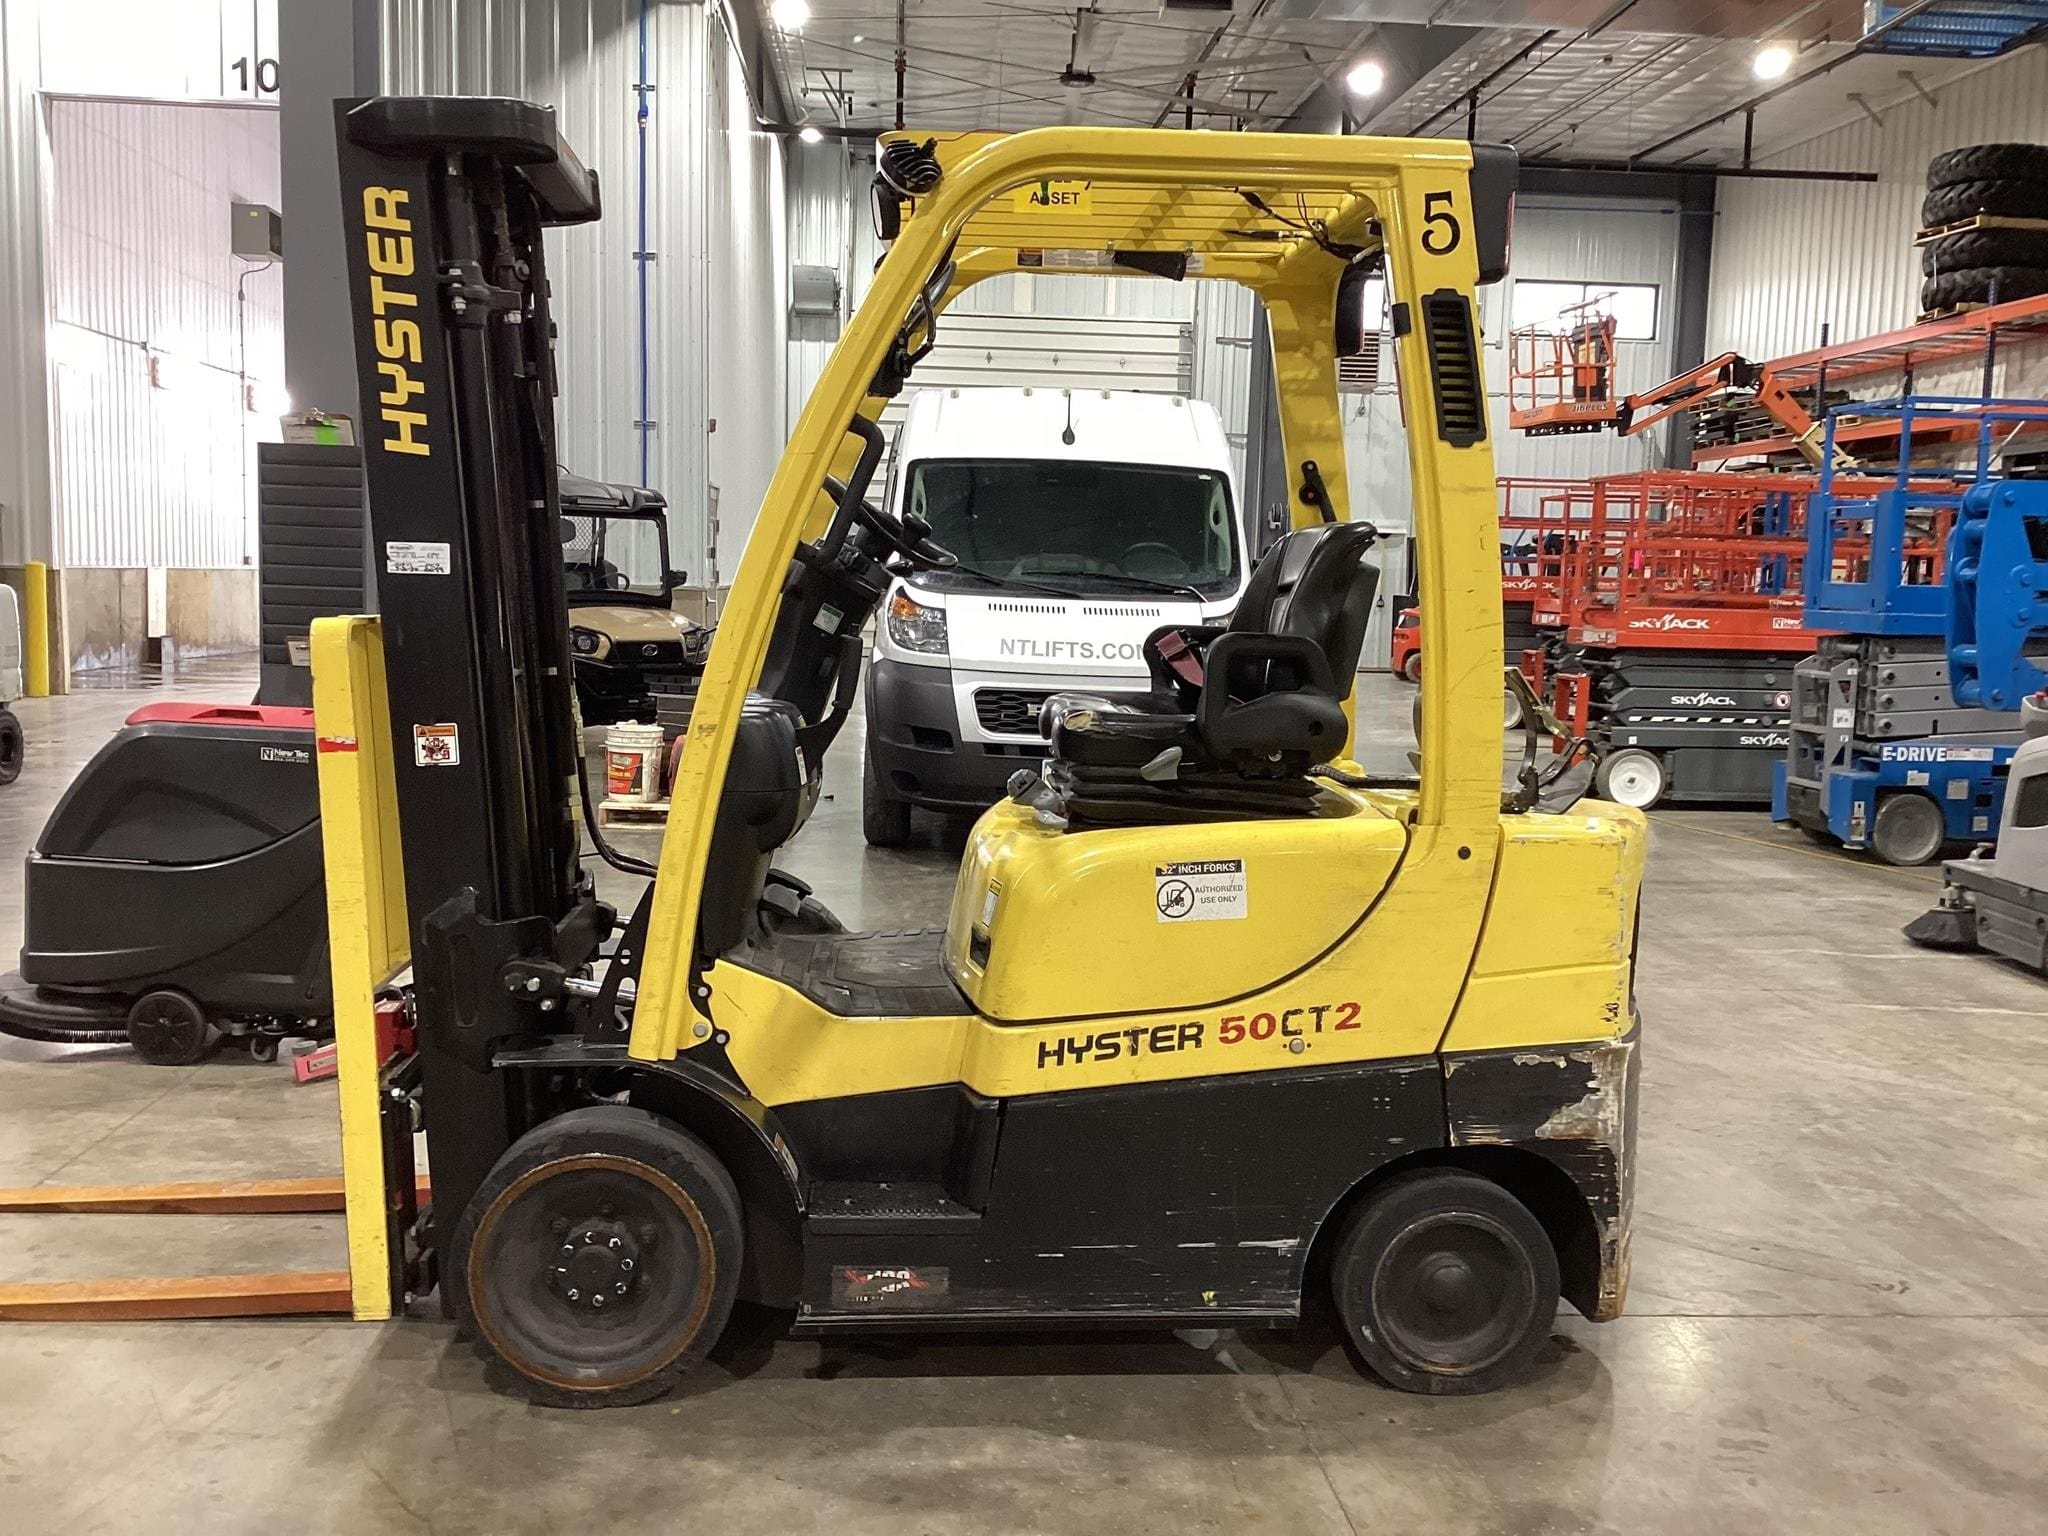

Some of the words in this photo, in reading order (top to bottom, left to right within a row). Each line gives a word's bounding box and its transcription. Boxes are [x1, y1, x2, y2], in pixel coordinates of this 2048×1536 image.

[231, 56, 280, 93] 10
[1029, 191, 1080, 206] ASET
[1421, 190, 1461, 256] 5
[363, 186, 430, 456] HYSTER
[1629, 613, 1710, 630] SKYJACK
[274, 748, 294, 757] New
[1882, 746, 1947, 762] E-DRIVE
[1179, 864, 1201, 873] INCH
[1204, 862, 1235, 872] FORKS
[1195, 884, 1243, 894] AUTHORIZED
[1200, 896, 1216, 904] USE
[1217, 895, 1237, 903] ONLY
[1038, 1021, 1204, 1069] HYSTER
[1218, 1002, 1361, 1044] 50CT2
